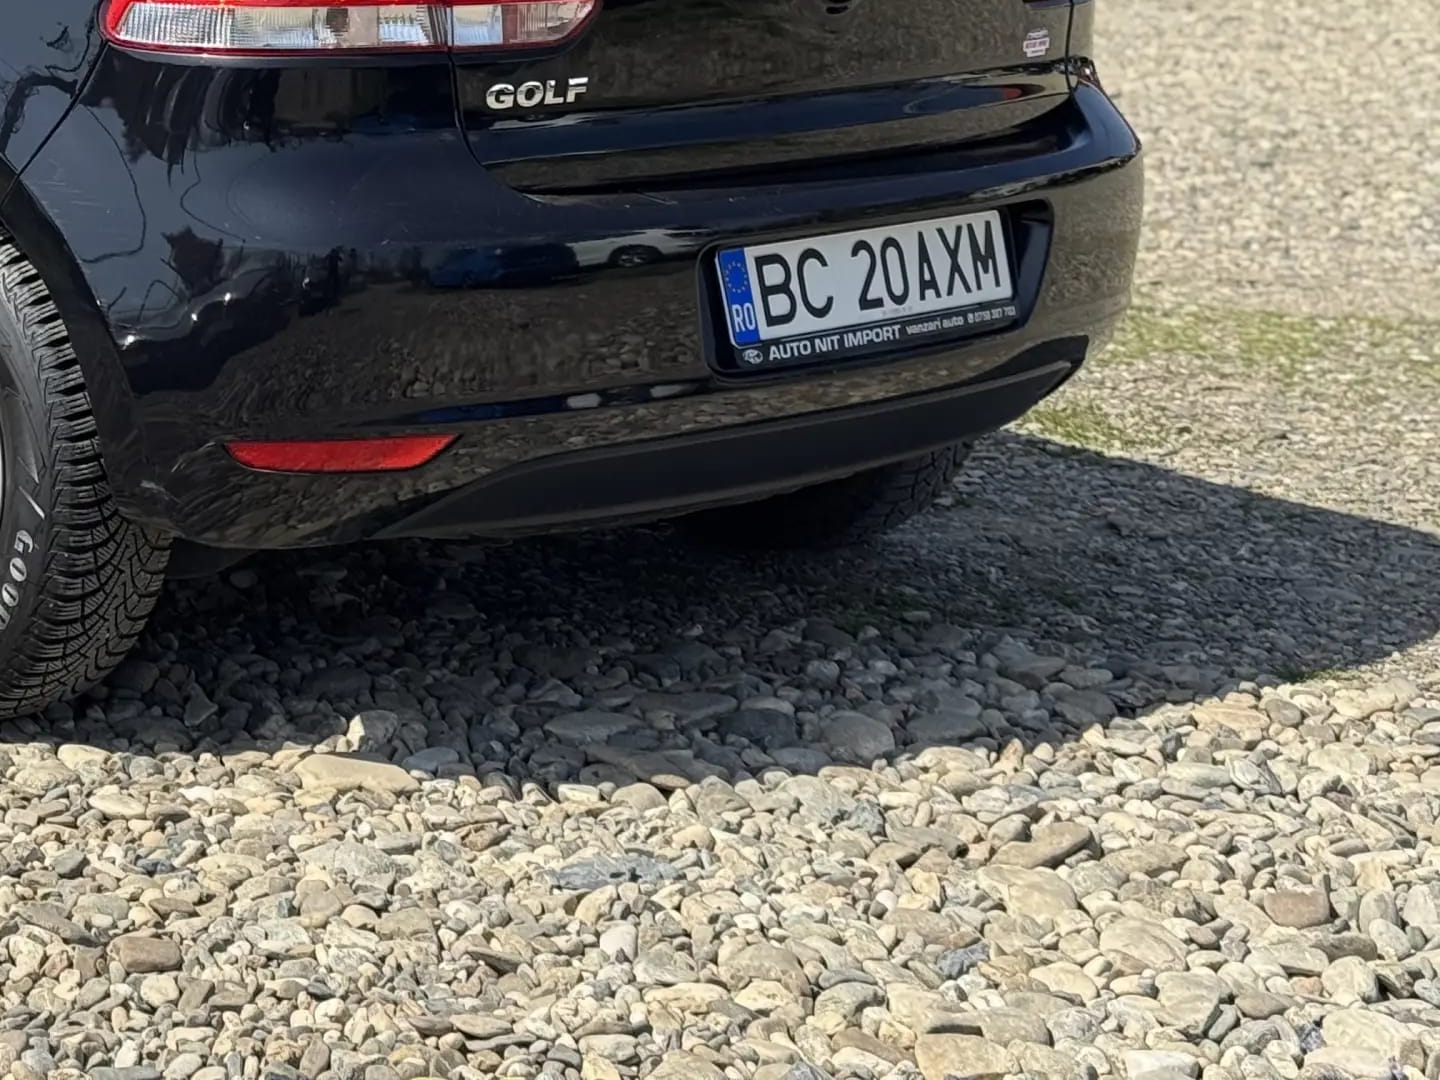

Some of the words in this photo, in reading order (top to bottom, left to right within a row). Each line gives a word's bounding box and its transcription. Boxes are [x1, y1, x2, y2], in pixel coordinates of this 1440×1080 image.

[486, 77, 588, 109] GOLF
[754, 248, 834, 328] BC
[735, 302, 756, 333] RO
[769, 341, 811, 361] AUTO
[814, 335, 841, 353] NIT
[843, 325, 901, 348] IMPORT
